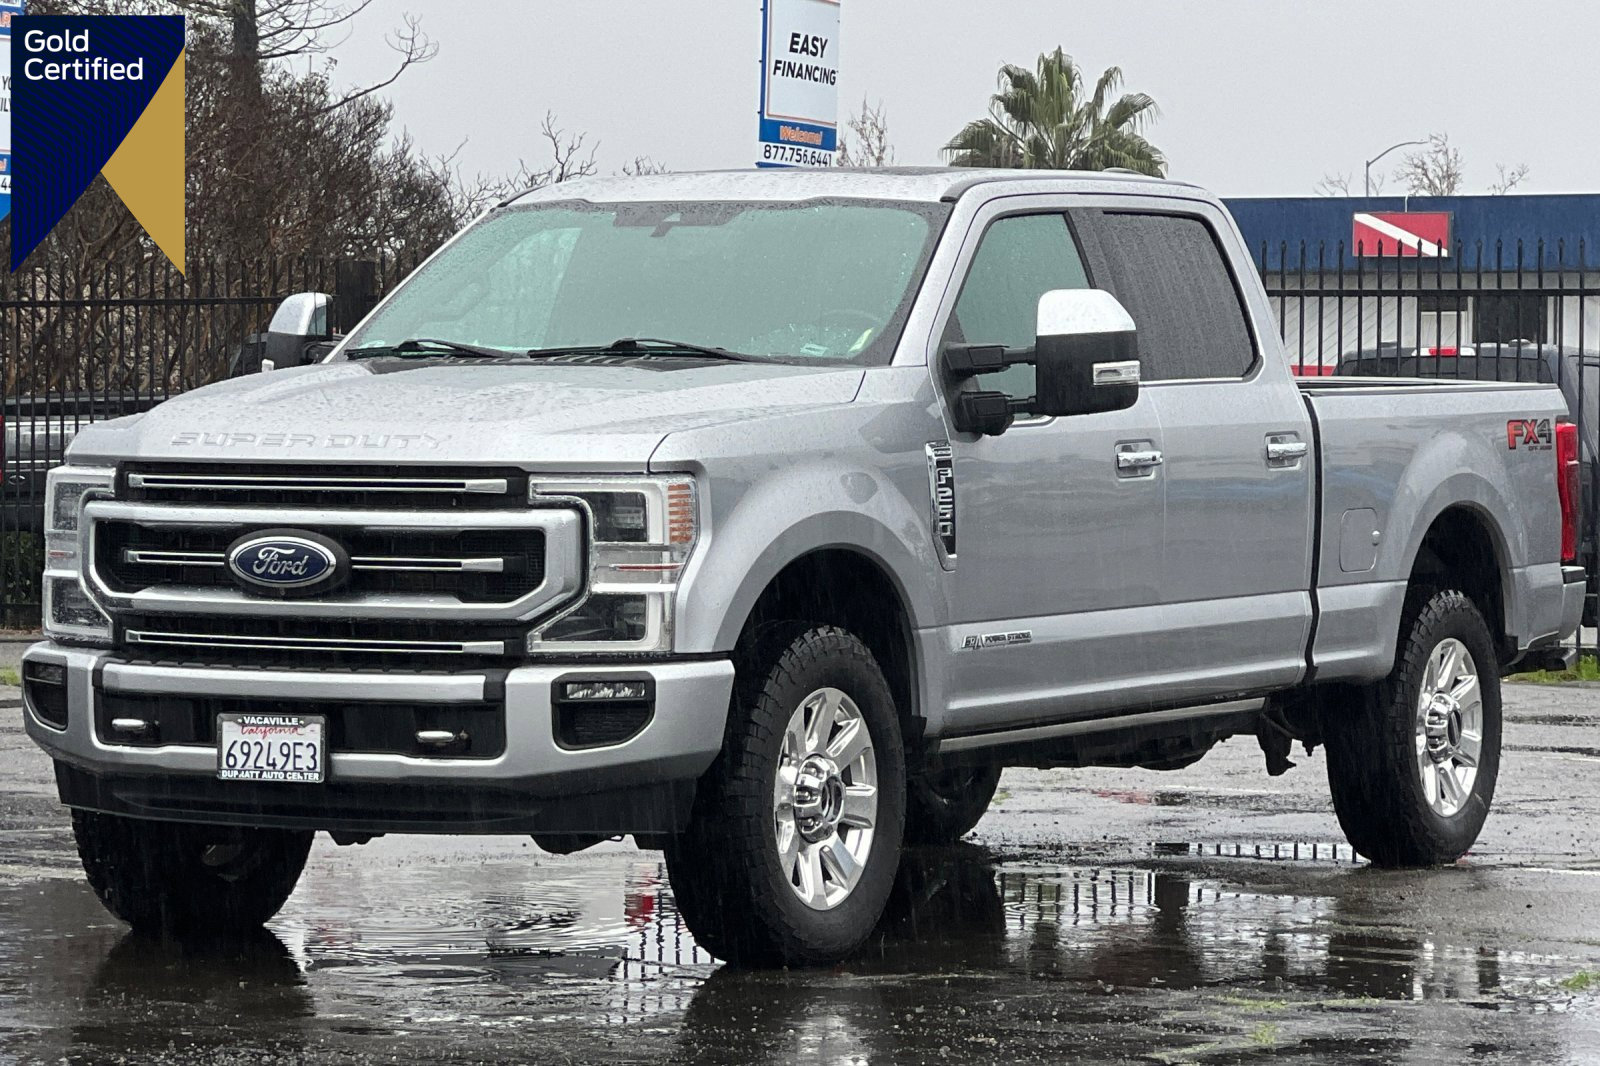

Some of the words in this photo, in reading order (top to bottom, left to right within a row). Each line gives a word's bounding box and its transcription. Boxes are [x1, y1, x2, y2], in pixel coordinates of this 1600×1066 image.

[789, 32, 828, 58] EASY
[773, 60, 836, 86] FINANCING
[764, 144, 832, 167] 877.756.6441
[170, 432, 315, 447] SUPER
[322, 434, 453, 449] DUTY
[1507, 419, 1552, 450] FX4
[253, 547, 309, 575] Ford
[240, 725, 304, 739] California
[243, 716, 299, 725] VACAVILLE
[225, 740, 317, 771] 69249E3
[262, 771, 285, 780] AUTO
